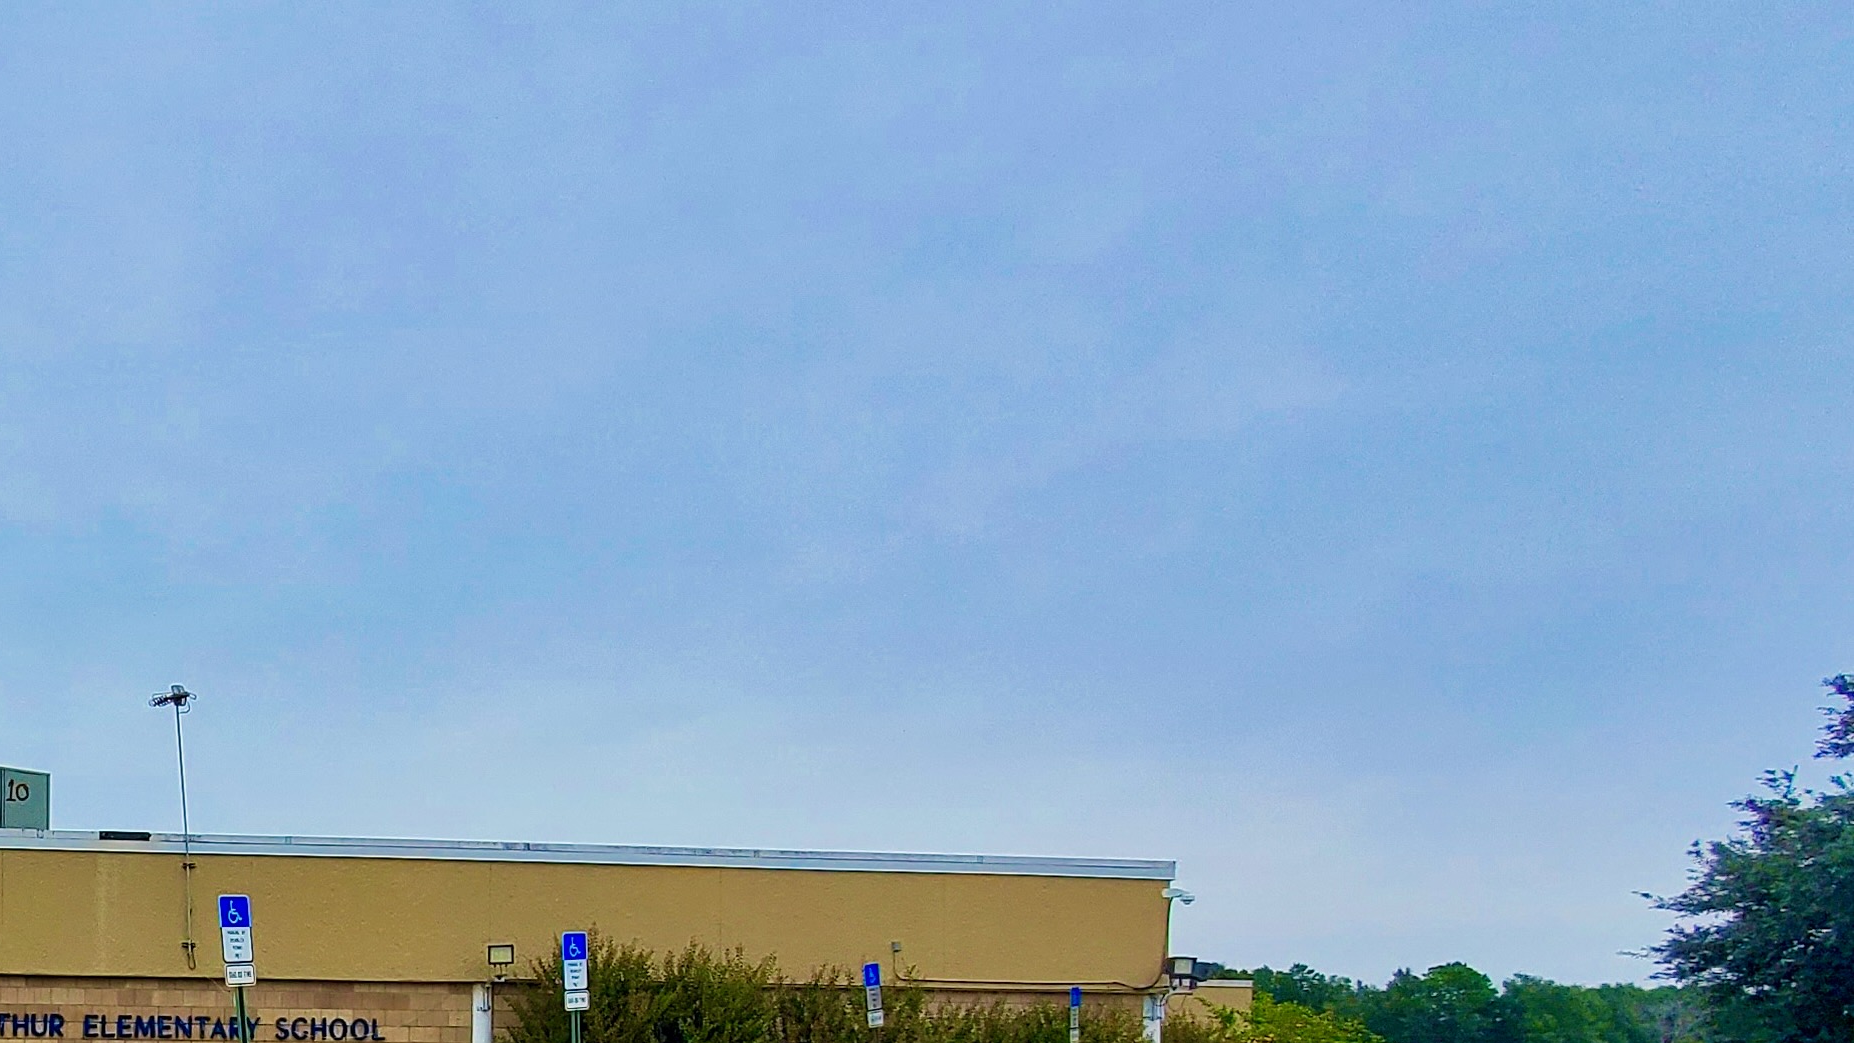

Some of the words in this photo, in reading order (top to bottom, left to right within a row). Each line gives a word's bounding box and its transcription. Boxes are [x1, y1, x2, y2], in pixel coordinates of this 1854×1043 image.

[6, 779, 29, 802] 10
[83, 1014, 261, 1040] ELEMENTARY
[274, 1017, 386, 1041] SCHOOL
